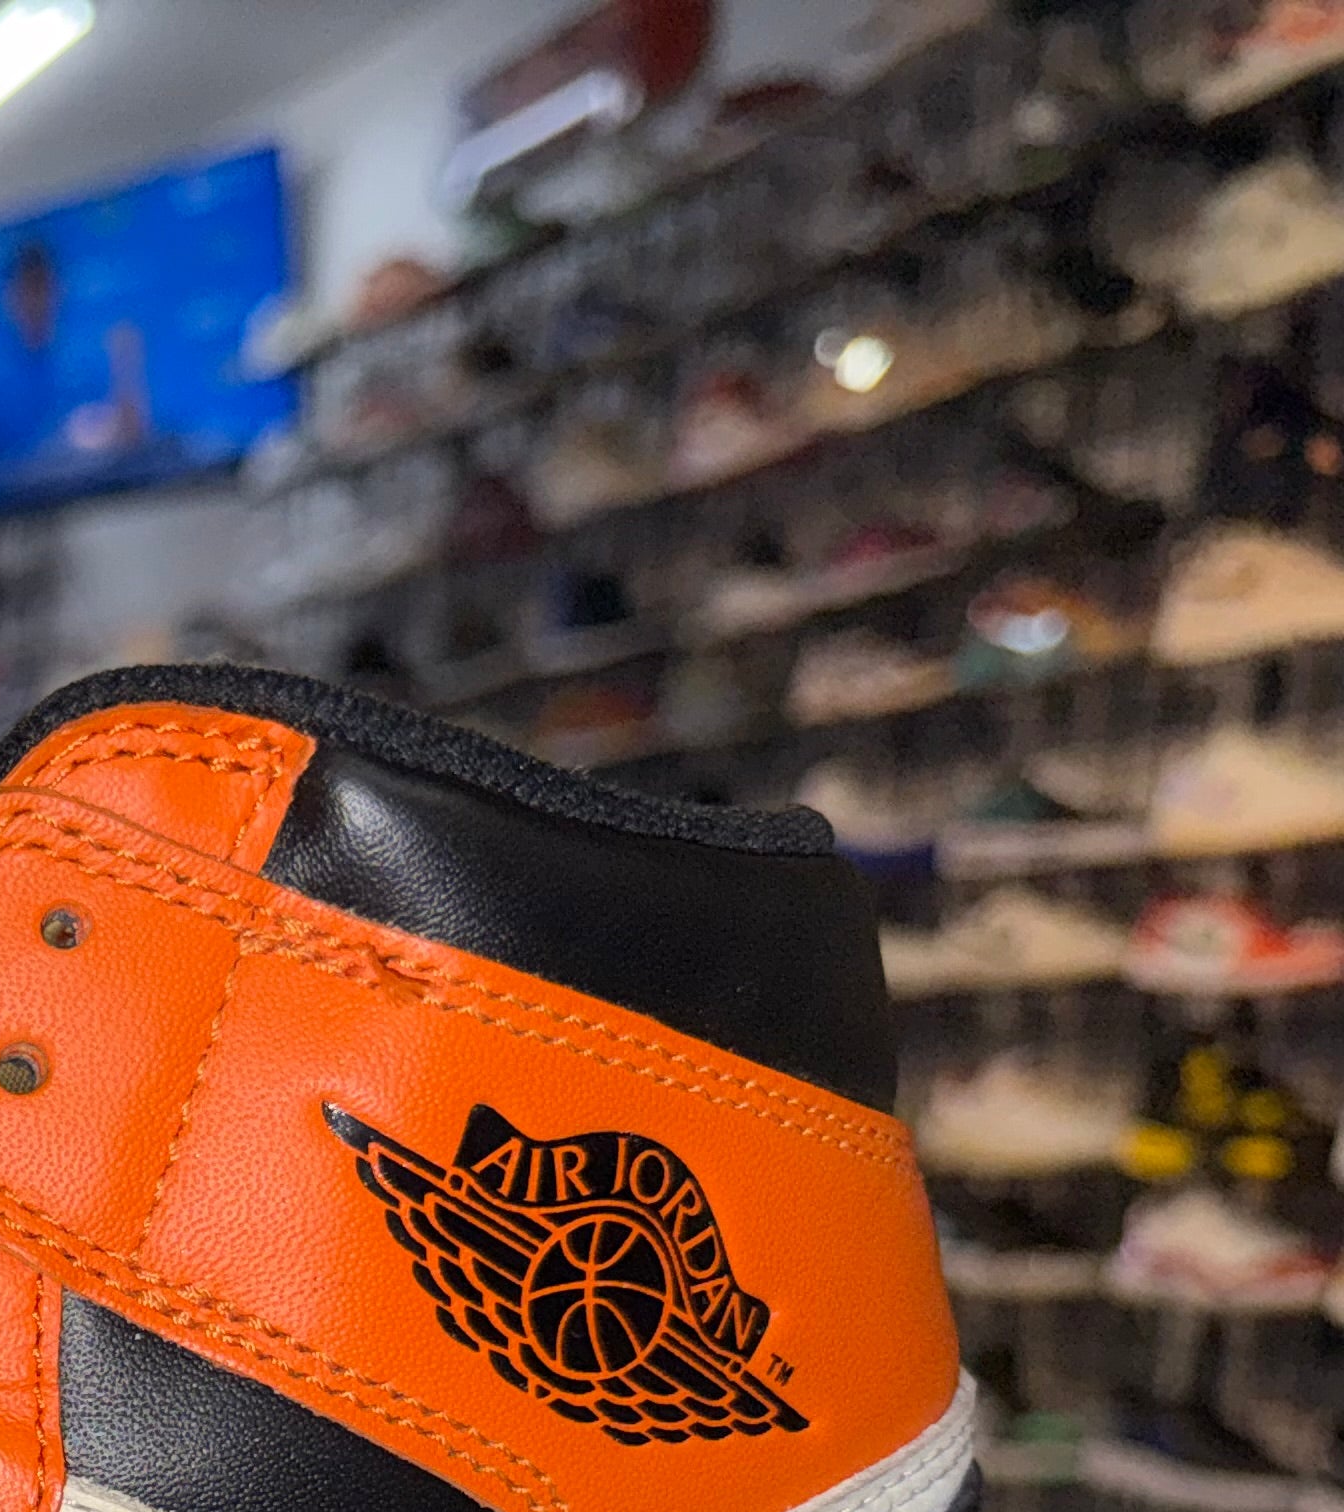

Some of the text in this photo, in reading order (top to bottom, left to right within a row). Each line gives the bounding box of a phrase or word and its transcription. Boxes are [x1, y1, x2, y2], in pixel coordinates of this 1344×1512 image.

[470, 1136, 758, 1350] AIR JORDAN
[765, 1352, 796, 1388] TM
